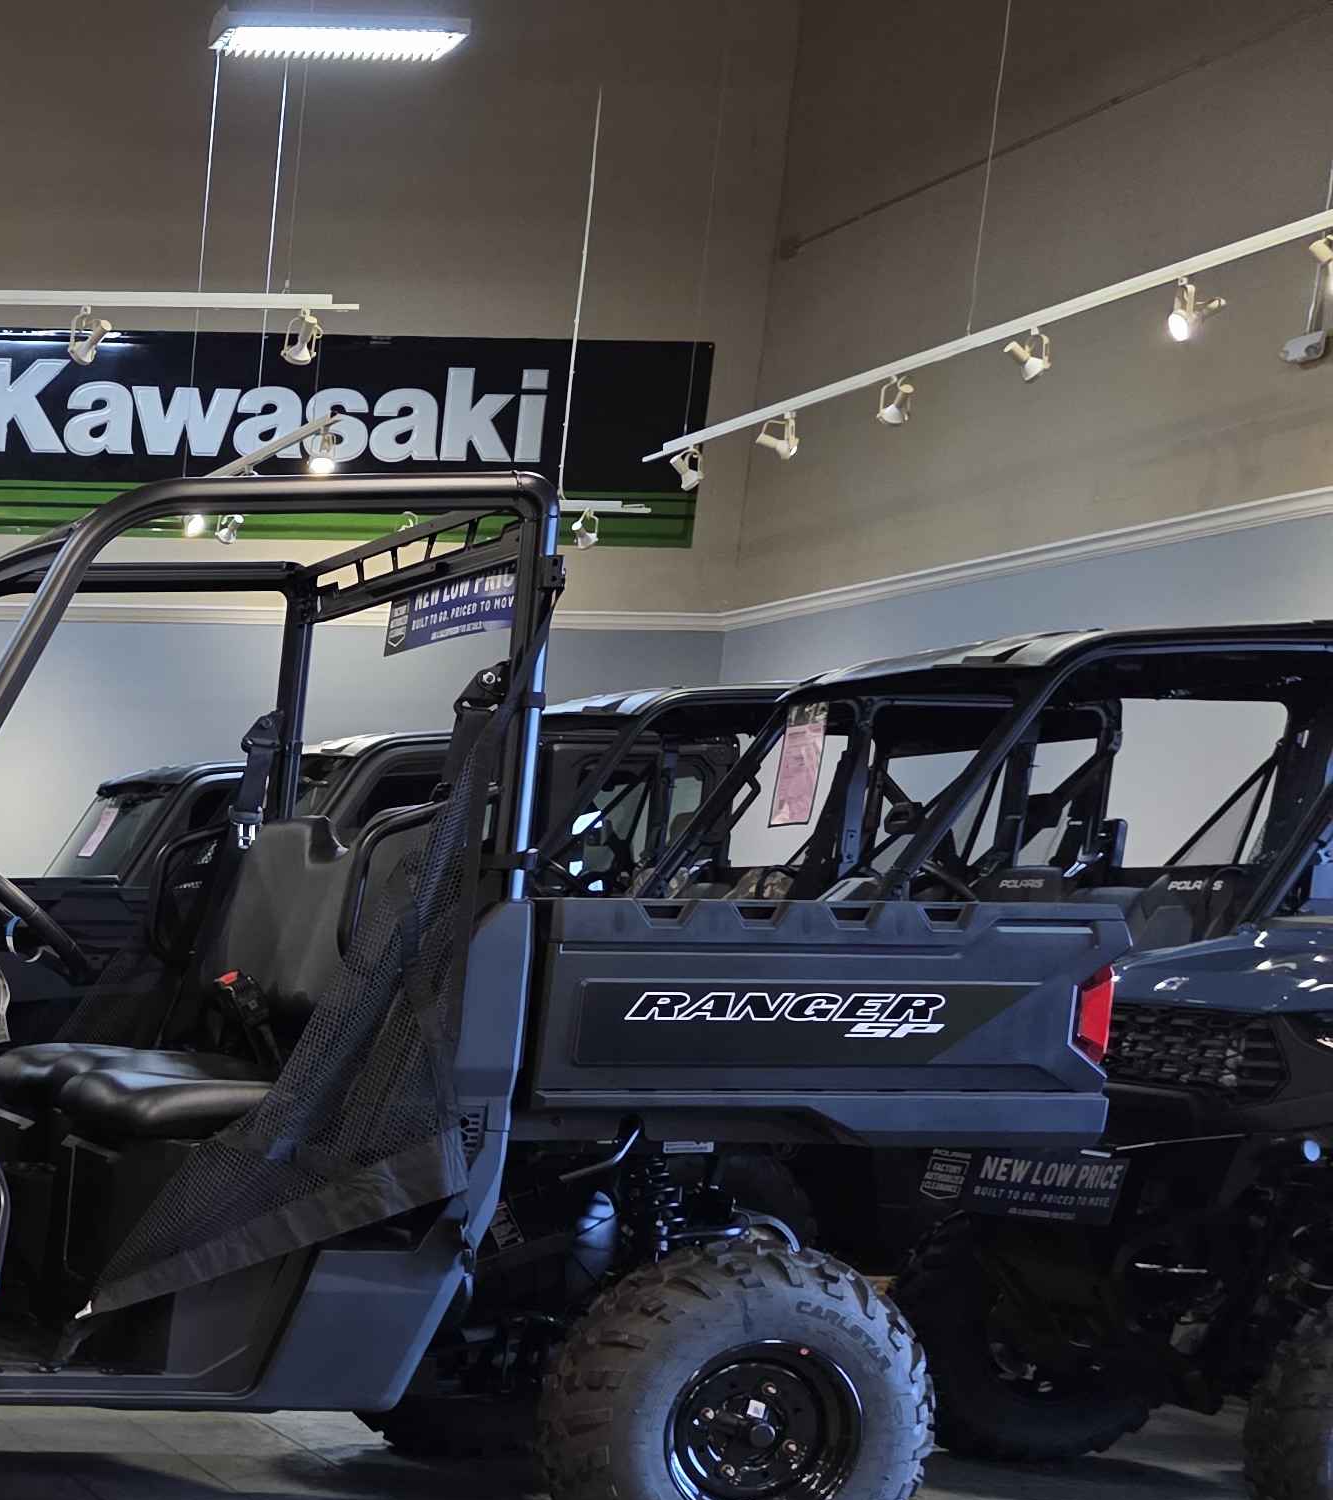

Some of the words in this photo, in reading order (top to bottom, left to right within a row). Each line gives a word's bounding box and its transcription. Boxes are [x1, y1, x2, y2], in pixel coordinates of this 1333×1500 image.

[473, 567, 515, 594] PRIC
[450, 602, 478, 619] PRICED
[480, 600, 491, 613] TO
[493, 595, 515, 610] MOV
[998, 878, 1045, 889] POLARIS
[1167, 880, 1224, 891] POLAS
[624, 991, 946, 1023] RANGER
[843, 1023, 945, 1038] SP
[979, 1155, 1033, 1183] NEW
[1030, 1161, 1077, 1188] LOW
[1074, 1164, 1124, 1190] PRICE
[973, 1185, 1006, 1199] BUILT
[1006, 1189, 1021, 1200] TO
[1040, 1193, 1076, 1206] PRICED
[795, 1301, 892, 1373] CARLSTAR
